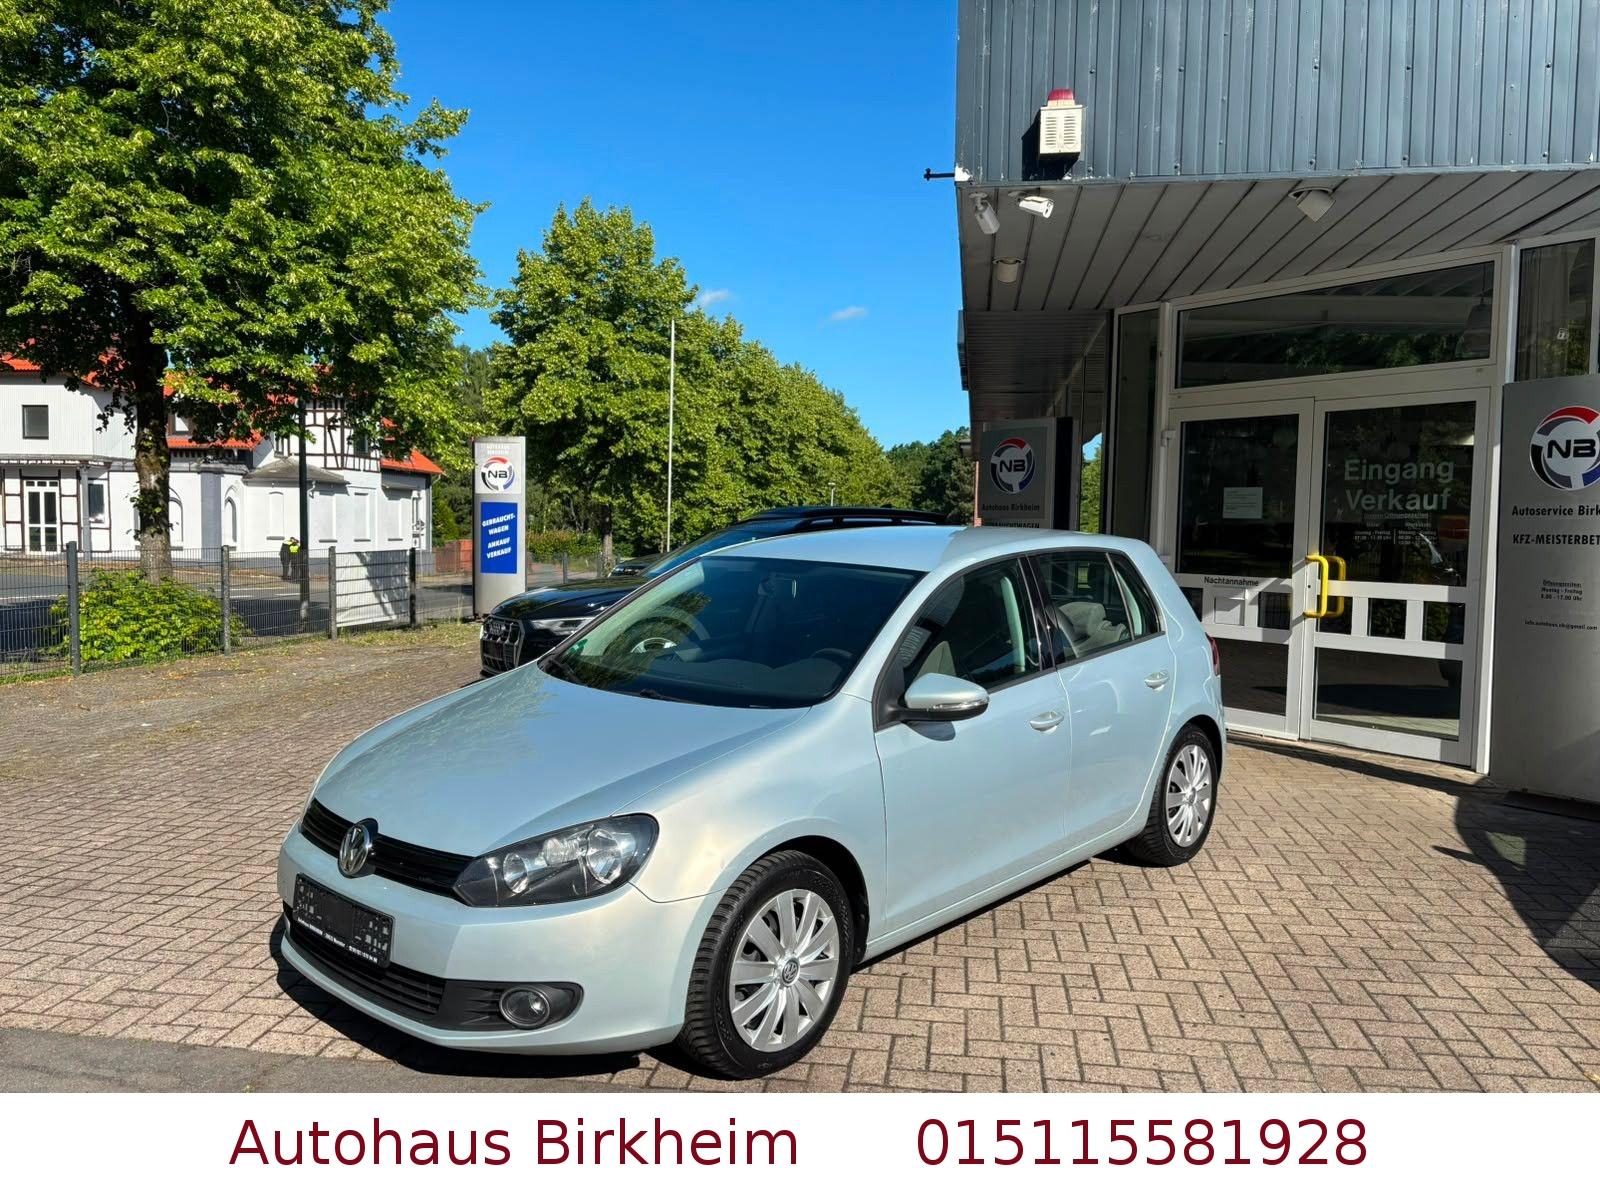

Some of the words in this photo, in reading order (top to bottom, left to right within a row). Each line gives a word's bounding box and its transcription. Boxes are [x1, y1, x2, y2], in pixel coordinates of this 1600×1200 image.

[1547, 439, 1596, 459] NB
[1000, 460, 1026, 473] NB
[1344, 459, 1454, 485] Eingang
[488, 470, 508, 479] NB
[1345, 488, 1451, 511] Verkauf
[1512, 505, 1574, 516] Autoservice
[1204, 576, 1259, 587] Nachtannahme
